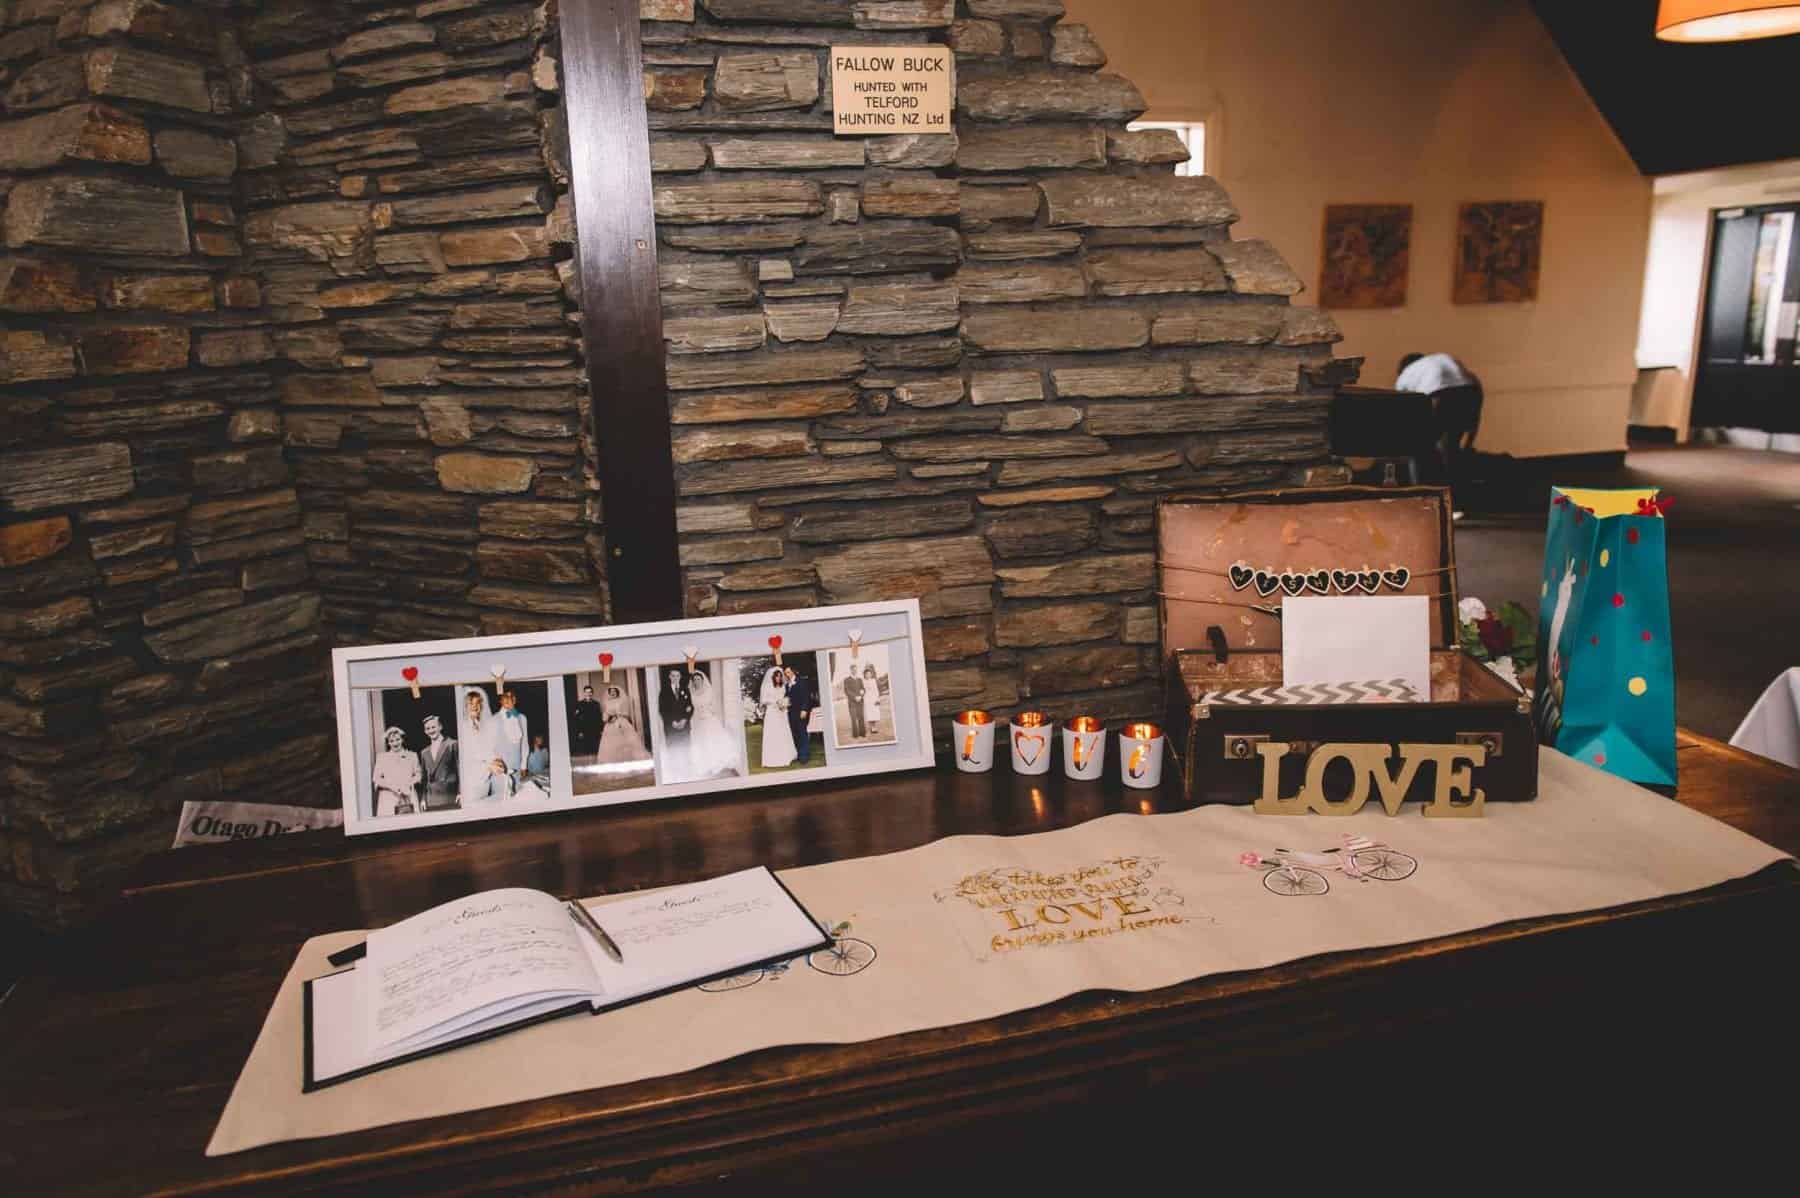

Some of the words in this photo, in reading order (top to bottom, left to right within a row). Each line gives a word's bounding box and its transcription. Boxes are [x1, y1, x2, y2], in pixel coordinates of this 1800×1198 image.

[836, 57, 895, 72] FALLOW
[903, 57, 944, 72] BUCK
[854, 82, 896, 92] HUNTED
[902, 82, 928, 92] WITH
[864, 97, 919, 108] TELFORD
[839, 113, 896, 125] HUNTING
[902, 113, 920, 125] NZ
[926, 113, 944, 125] Ltd
[1253, 743, 1486, 817] LOVE
[191, 815, 259, 841] Otago
[998, 893, 1152, 932] LOVE
